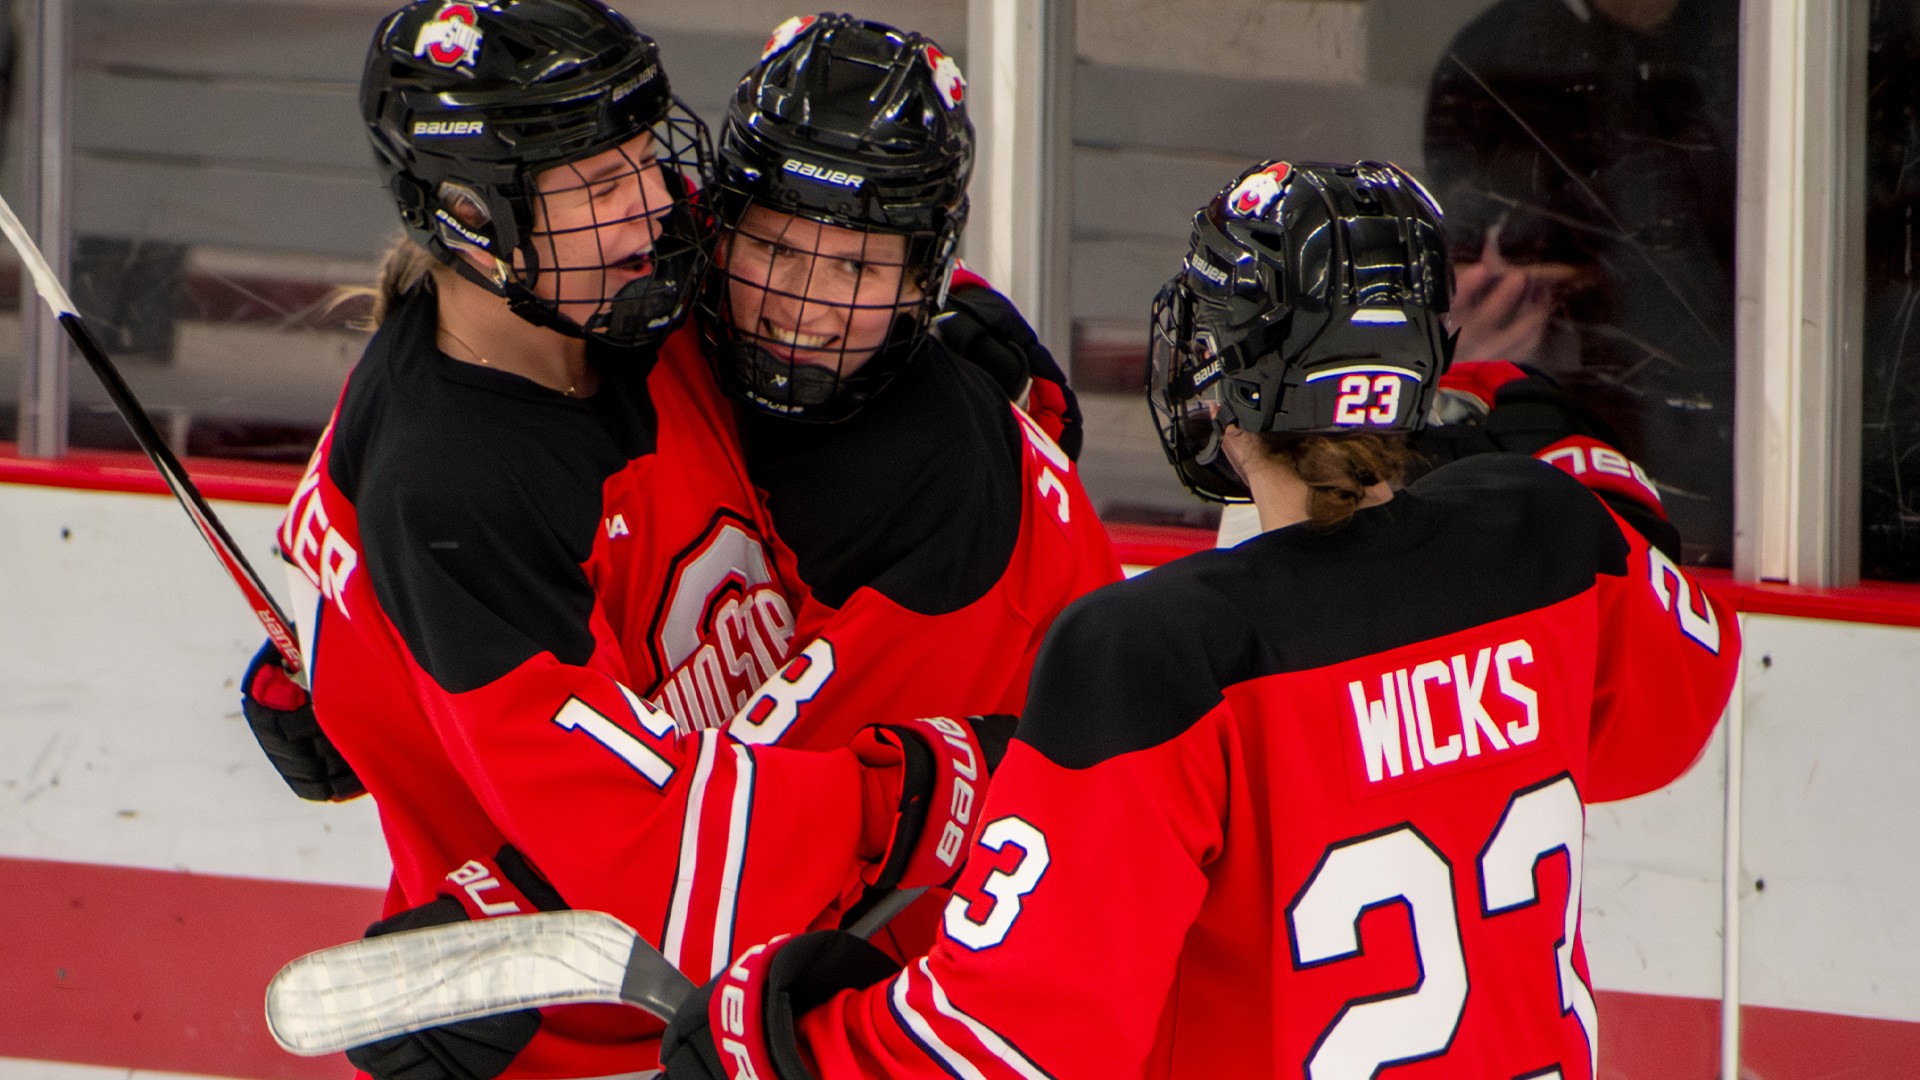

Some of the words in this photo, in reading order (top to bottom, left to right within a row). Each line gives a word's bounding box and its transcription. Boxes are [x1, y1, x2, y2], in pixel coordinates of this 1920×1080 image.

[413, 121, 484, 136] BAUER
[782, 158, 866, 188] BAUER
[1193, 360, 1222, 386] BAUE
[1334, 374, 1402, 427] 23
[726, 637, 836, 747] 8
[1348, 638, 1541, 783] WICKS
[1284, 769, 1598, 1080] 23
